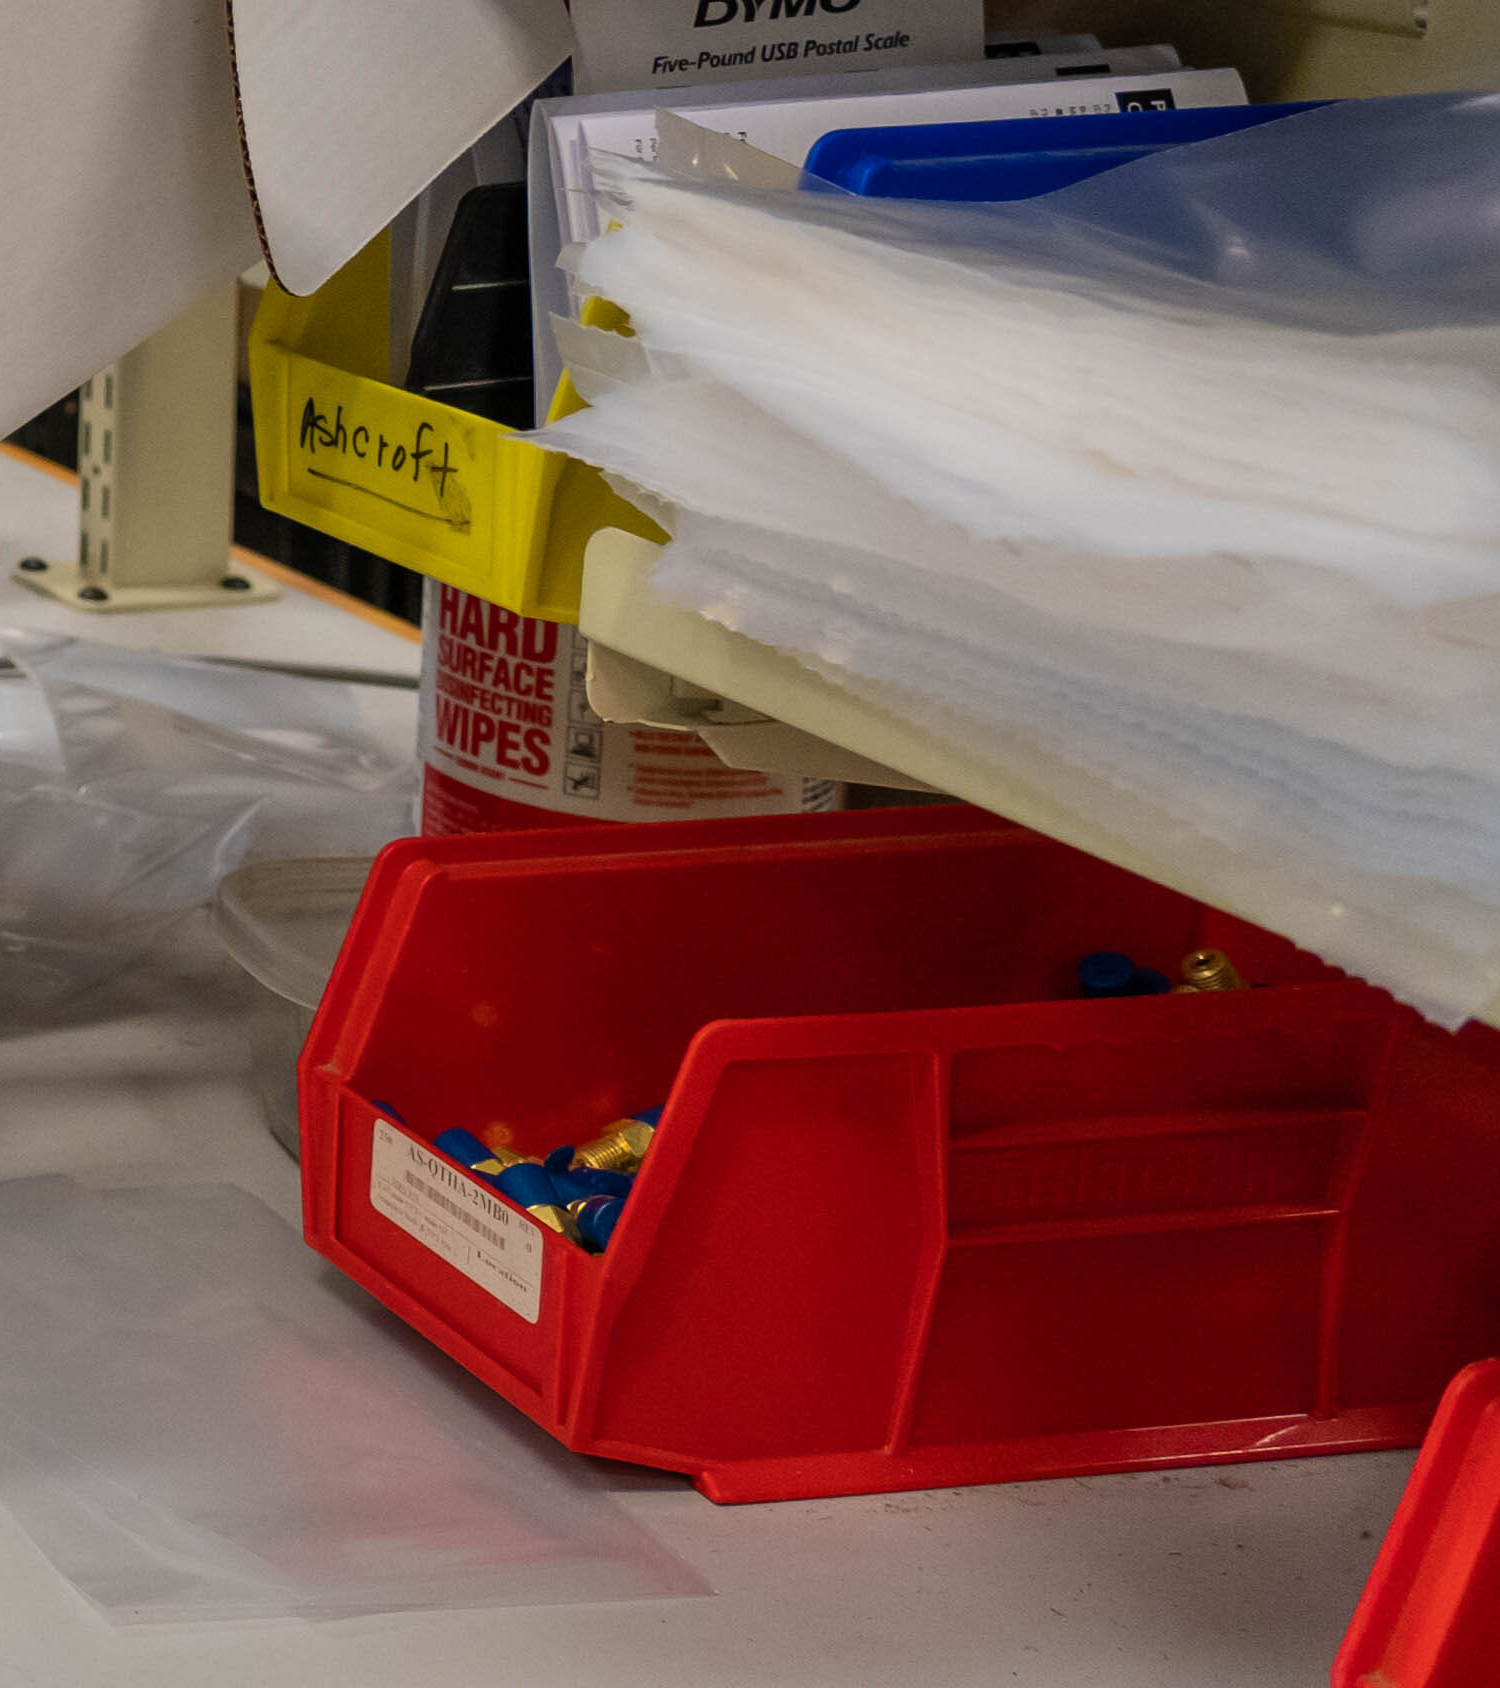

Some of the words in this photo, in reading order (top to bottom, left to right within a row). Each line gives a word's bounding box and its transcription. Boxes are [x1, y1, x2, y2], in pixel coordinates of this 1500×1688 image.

[652, 46, 757, 75] Five-Pound
[761, 41, 800, 63] USB
[803, 35, 860, 58] Postal
[863, 31, 911, 52] Scale
[300, 397, 458, 499] Ashcroft
[439, 582, 559, 664] HARD
[435, 668, 553, 729] DISINFECTING
[438, 633, 554, 702] SURFACE
[434, 693, 552, 776] WIPES
